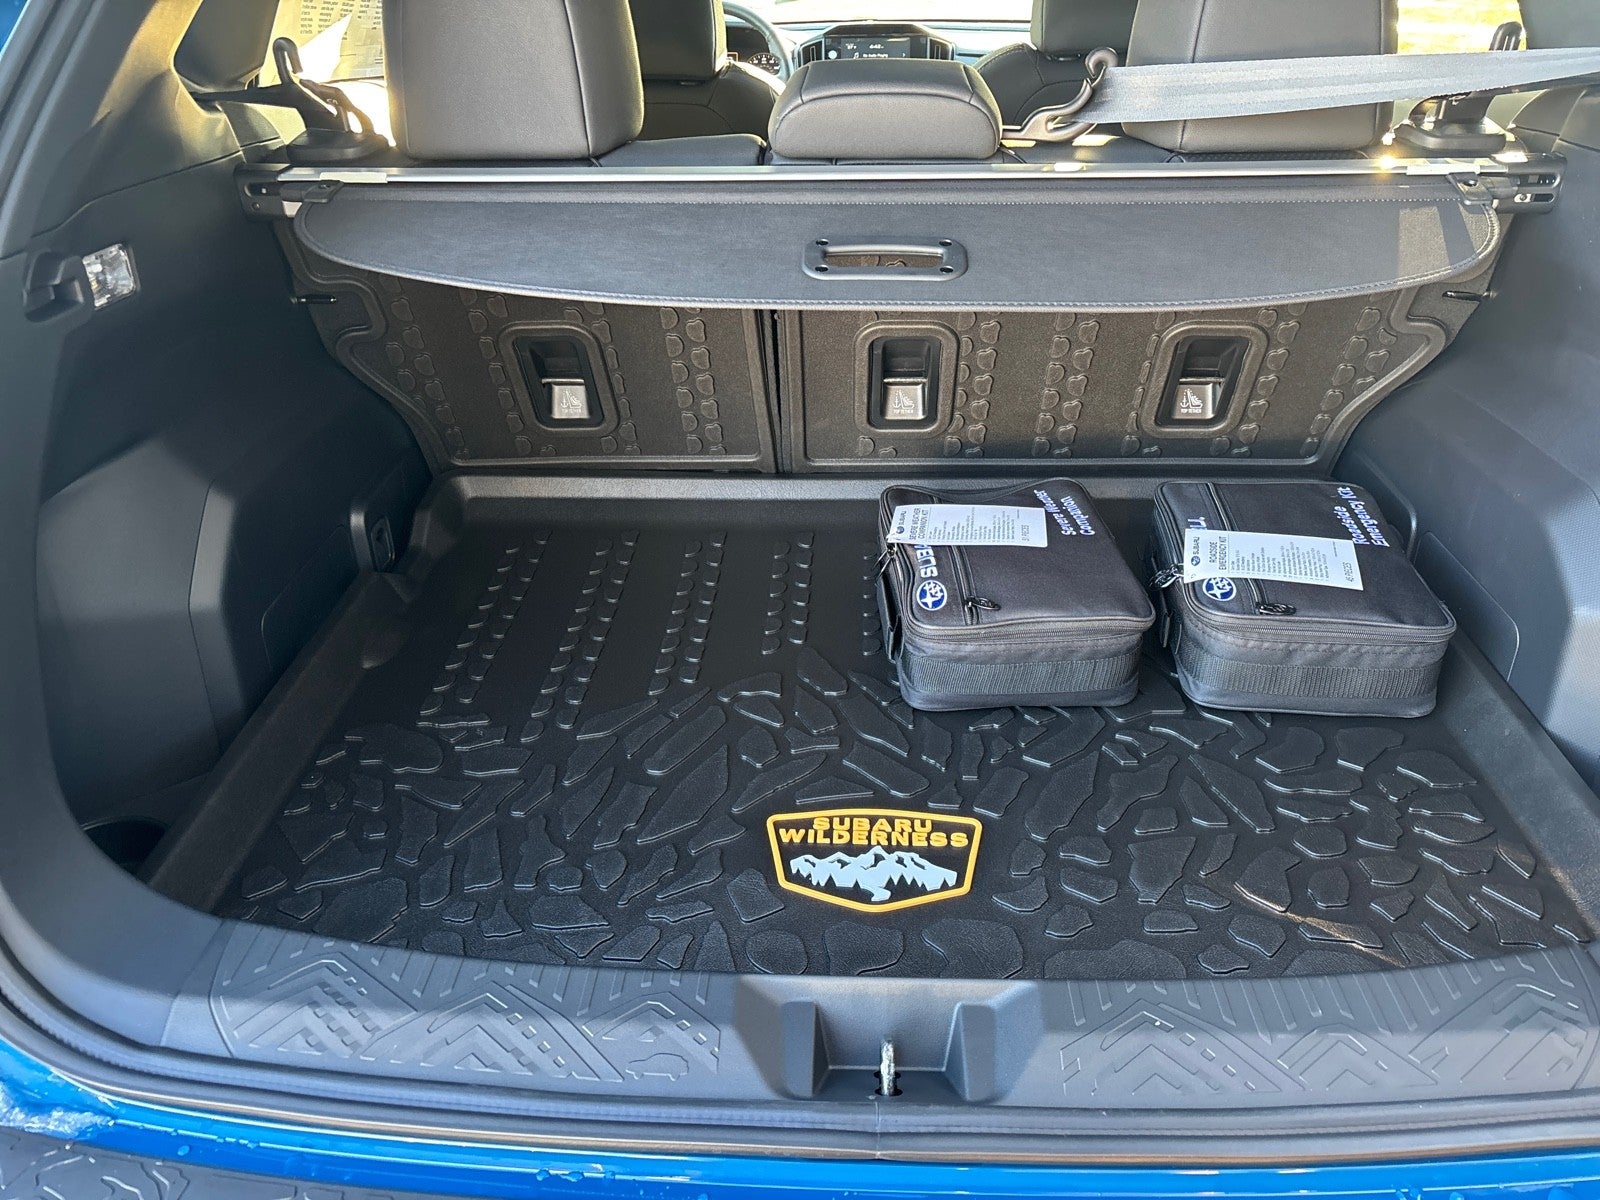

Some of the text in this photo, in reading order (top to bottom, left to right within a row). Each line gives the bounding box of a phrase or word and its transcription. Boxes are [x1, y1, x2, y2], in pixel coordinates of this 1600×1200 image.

[1060, 495, 1095, 536] Companion
[1333, 506, 1370, 545] Roadside
[1336, 486, 1390, 547] Emergency Kit
[779, 828, 968, 847] WILDERNESS
[812, 816, 933, 833] SUBARU
